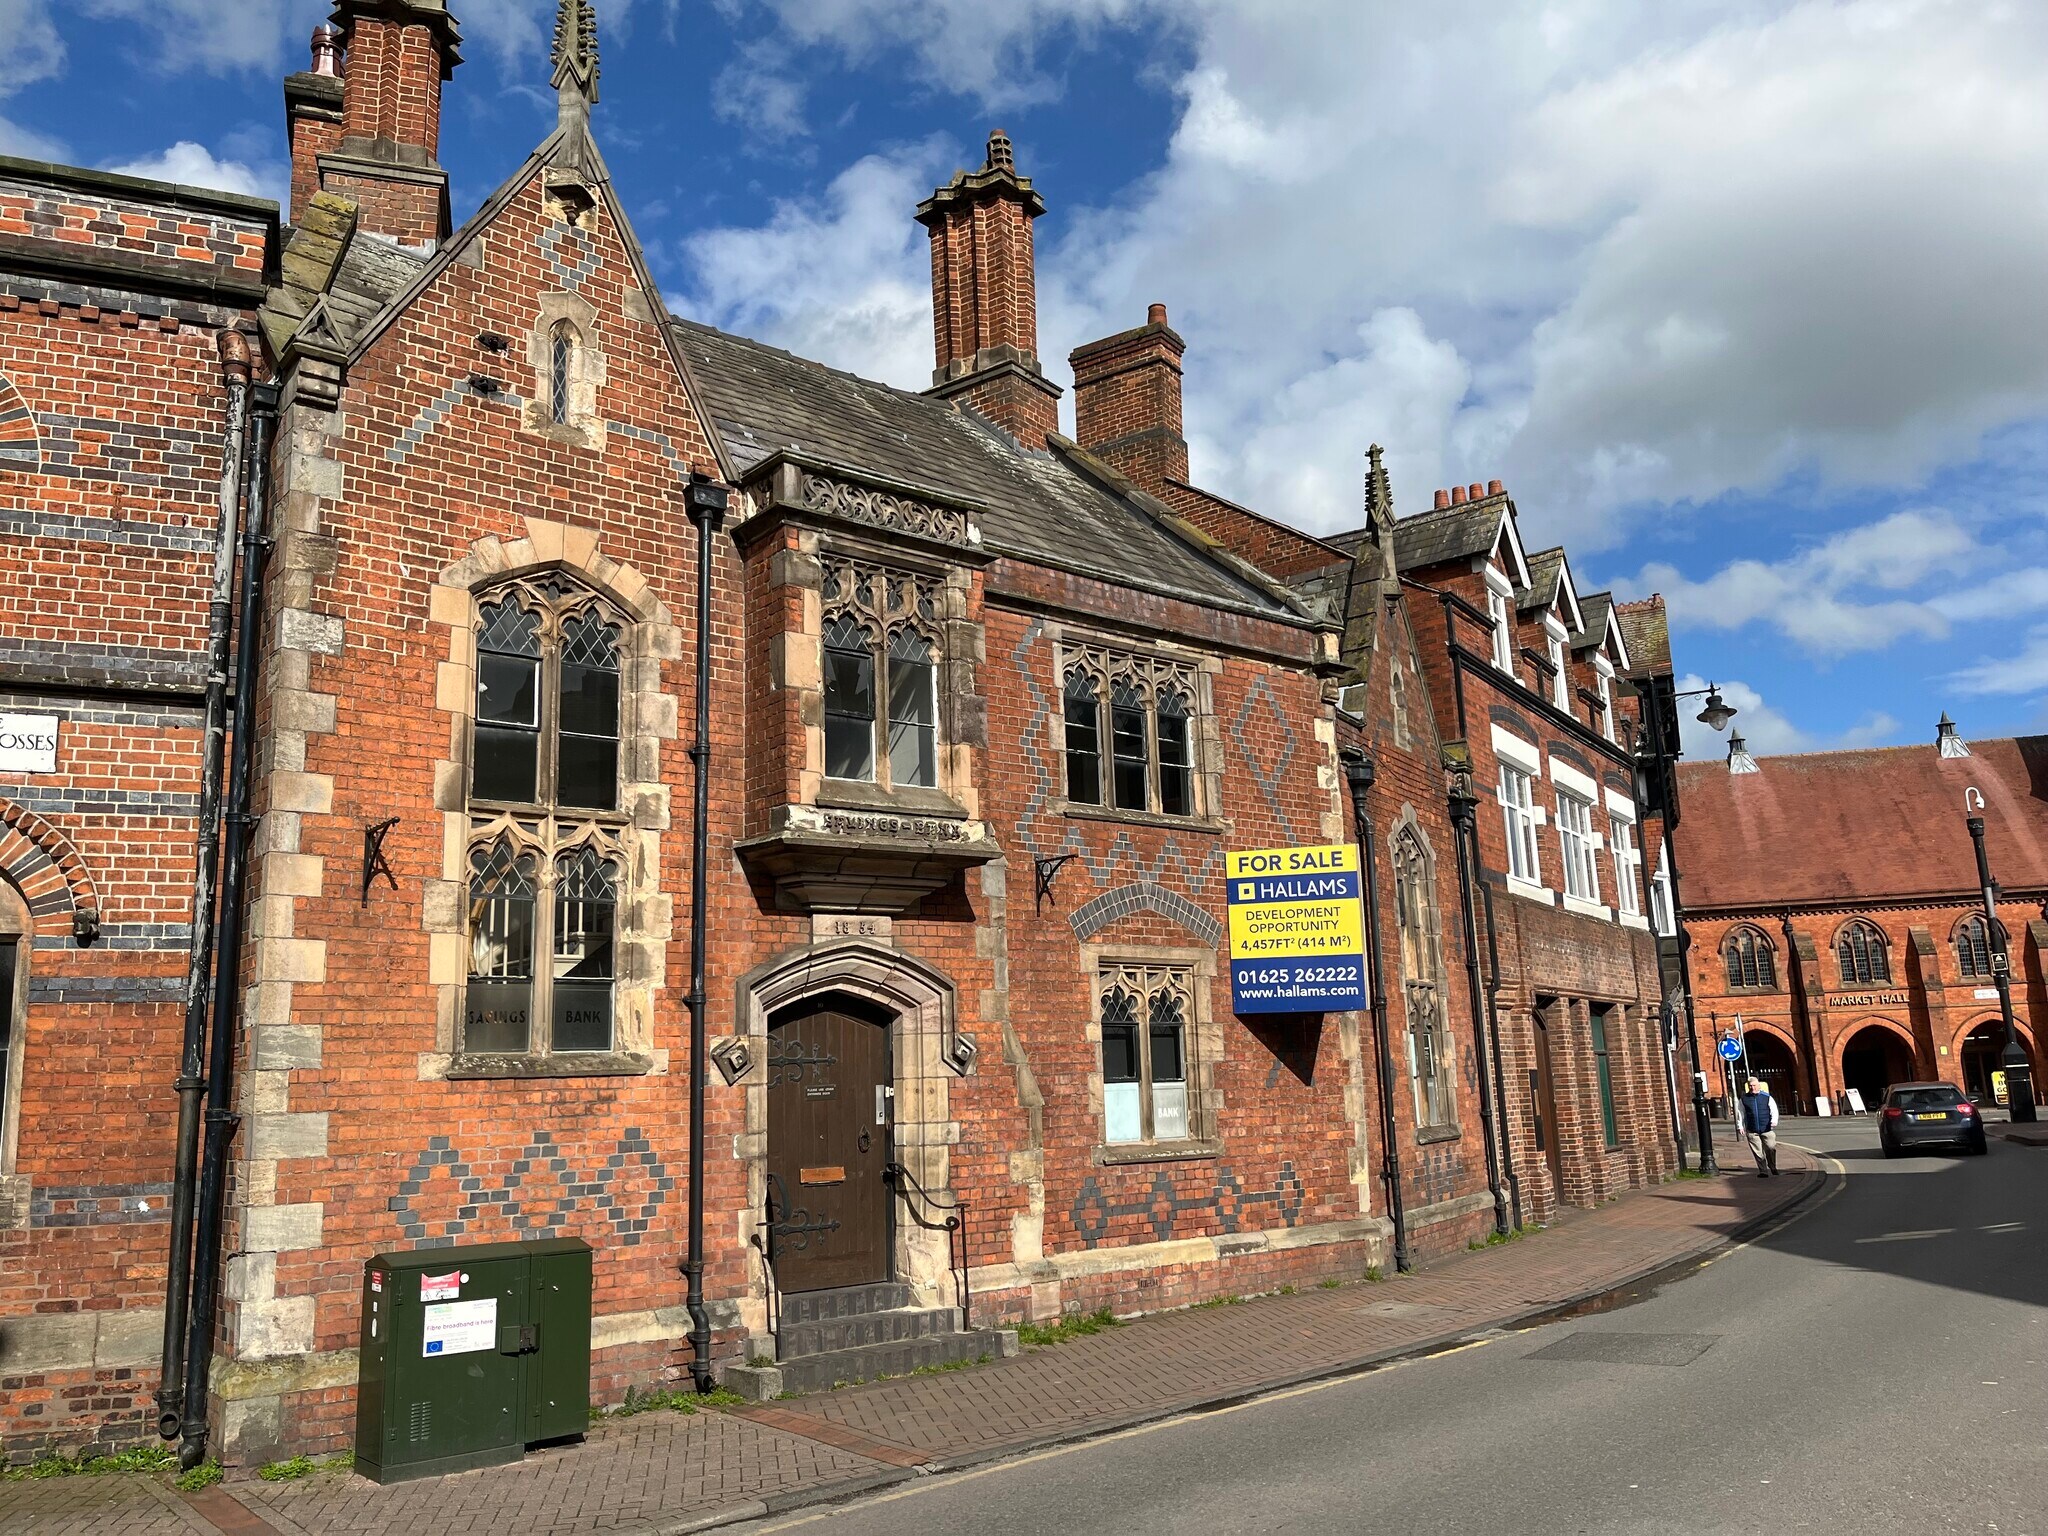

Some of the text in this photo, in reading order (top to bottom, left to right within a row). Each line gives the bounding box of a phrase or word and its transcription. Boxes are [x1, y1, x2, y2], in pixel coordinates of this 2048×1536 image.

[0, 733, 54, 751] OSSES
[1238, 851, 1344, 873] FOR SALE
[1260, 878, 1347, 899] HALLAMS
[1246, 906, 1341, 921] DEVELOPMENT
[1249, 920, 1339, 934] OPPORTUNITY
[1298, 937, 1326, 949] (414
[1238, 966, 1358, 985] 01625 262222
[1239, 984, 1359, 999] www.hallams.com
[1830, 993, 1910, 1006] MARKET HALL
[565, 1010, 601, 1024] BANK
[1158, 1107, 1179, 1118] BANK
[426, 1324, 442, 1332] Fibre
[443, 1320, 474, 1330] broadband
